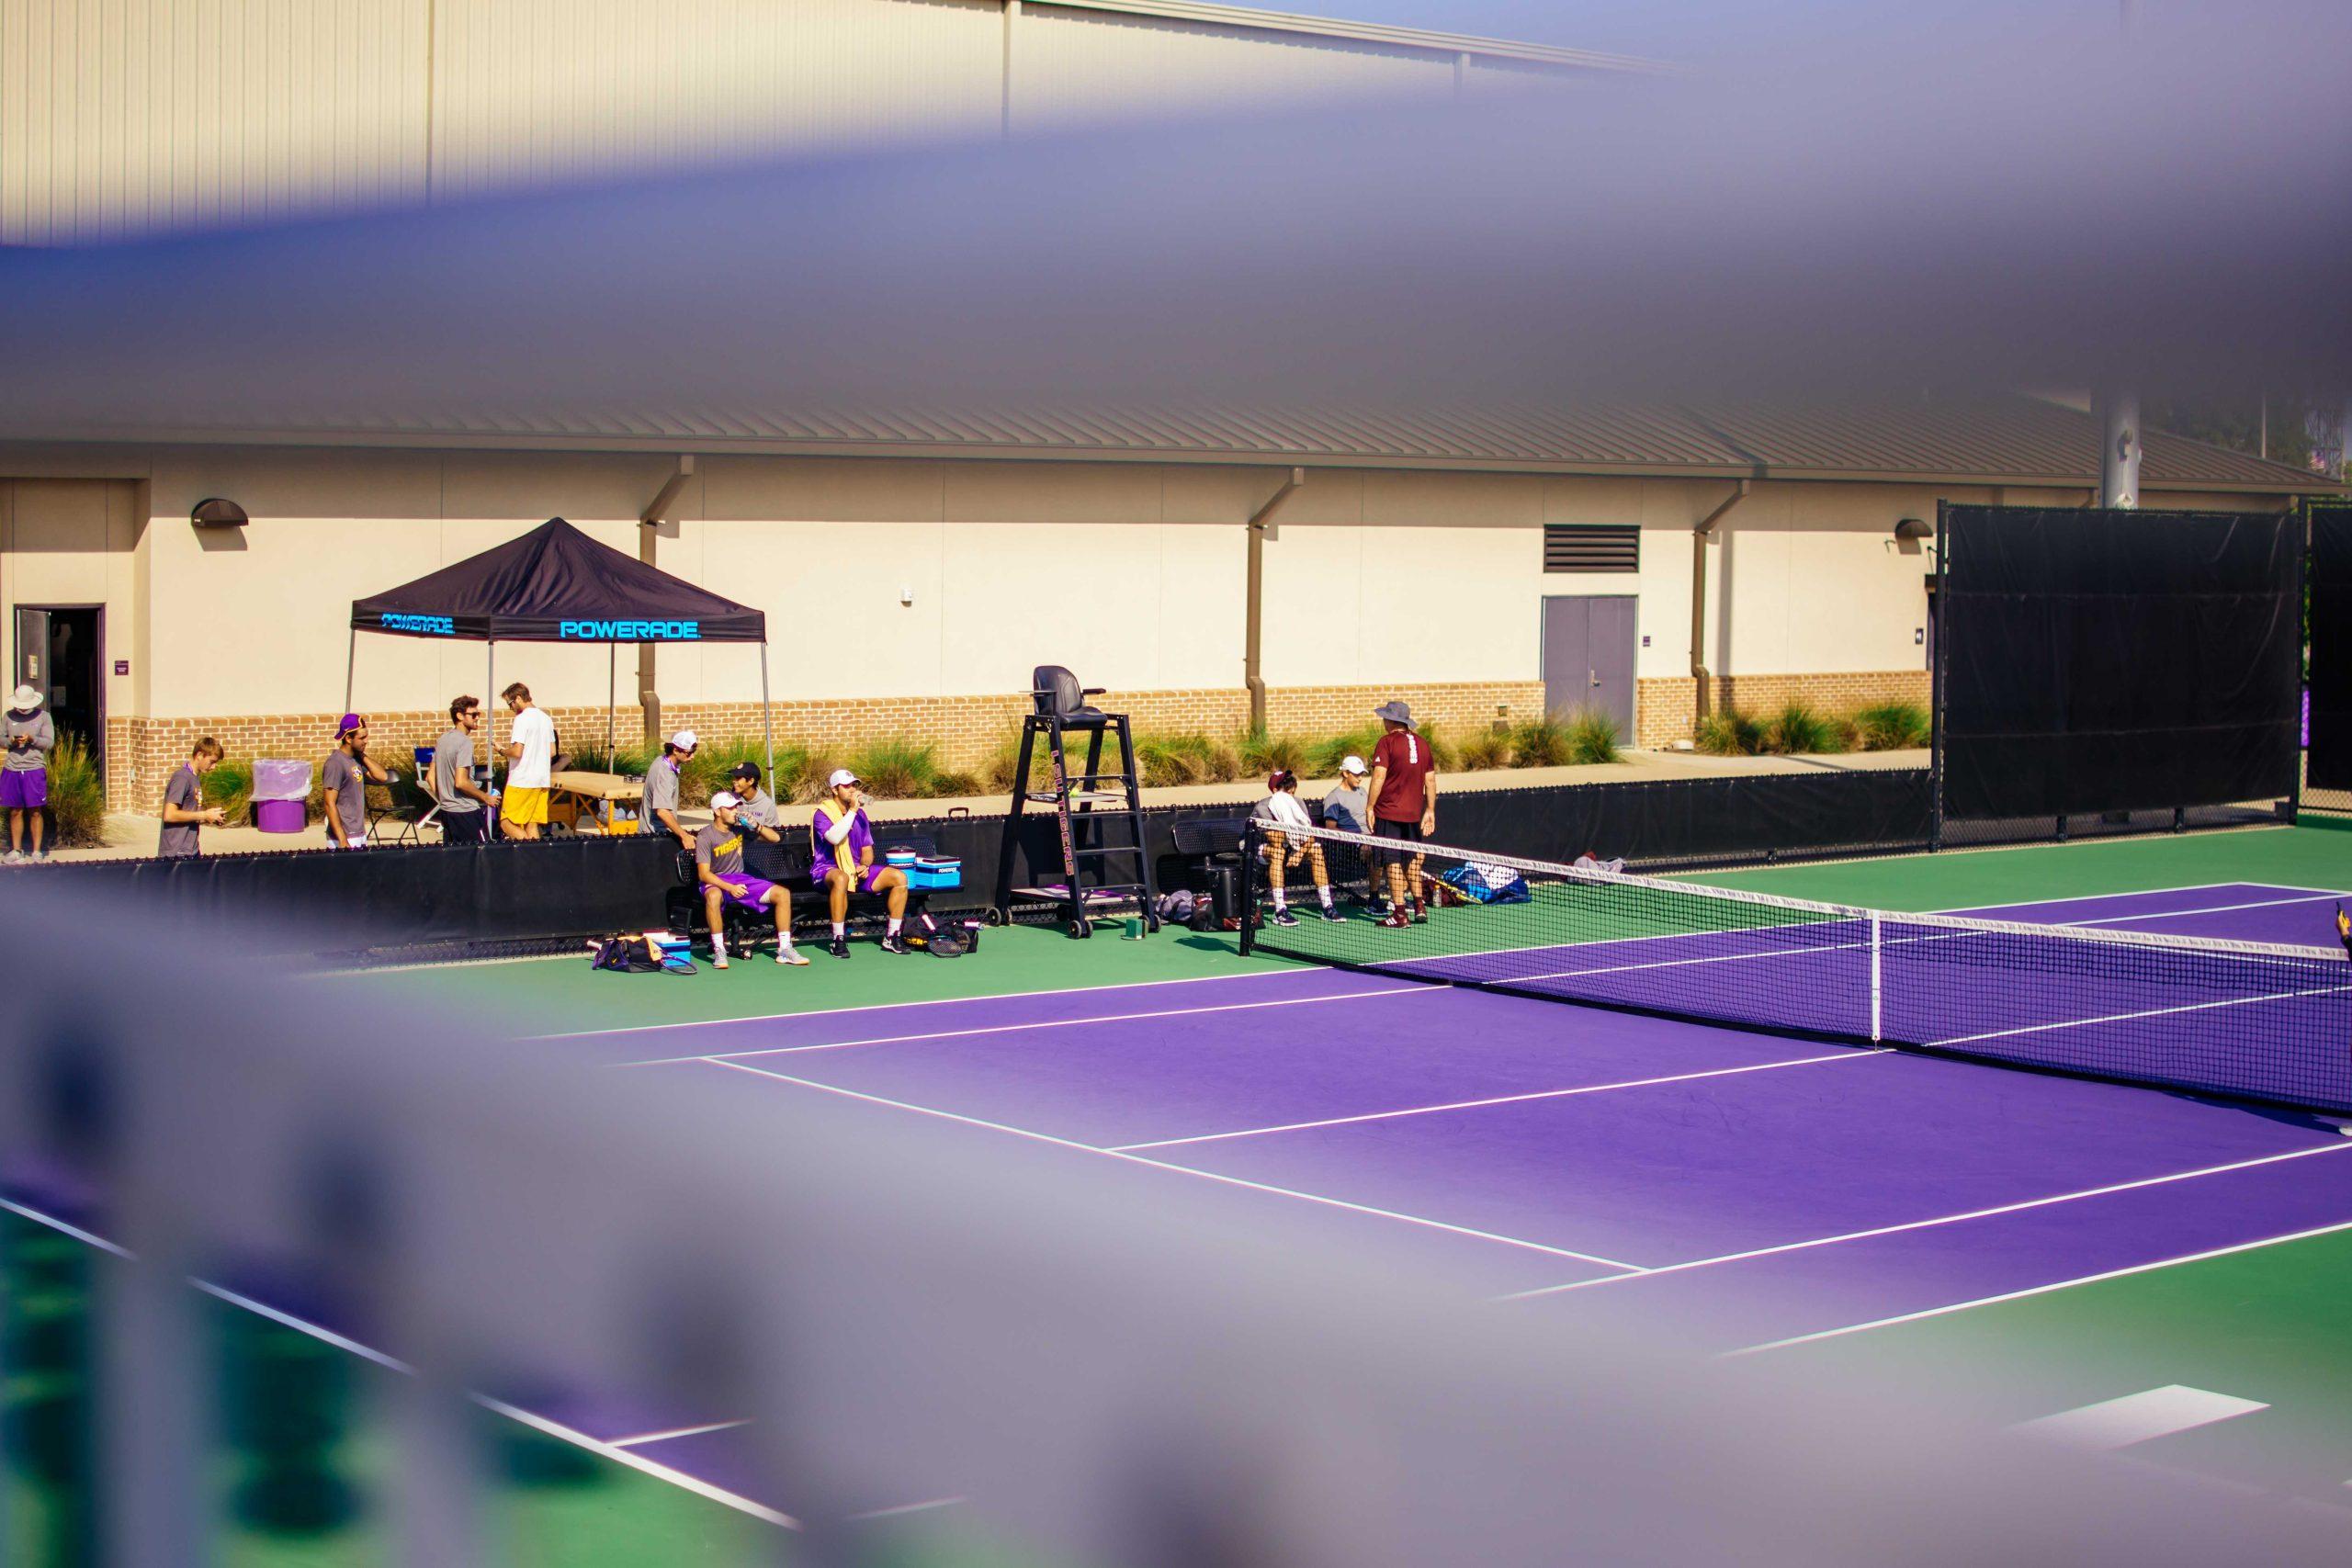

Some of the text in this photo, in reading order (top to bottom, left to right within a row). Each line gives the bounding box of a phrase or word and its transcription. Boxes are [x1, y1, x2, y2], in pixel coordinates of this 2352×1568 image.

[381, 613, 455, 634] POWERADE
[560, 621, 700, 638] POWERADE
[713, 834, 743, 858] TIGERS
[1057, 795, 1075, 876] TIGERS
